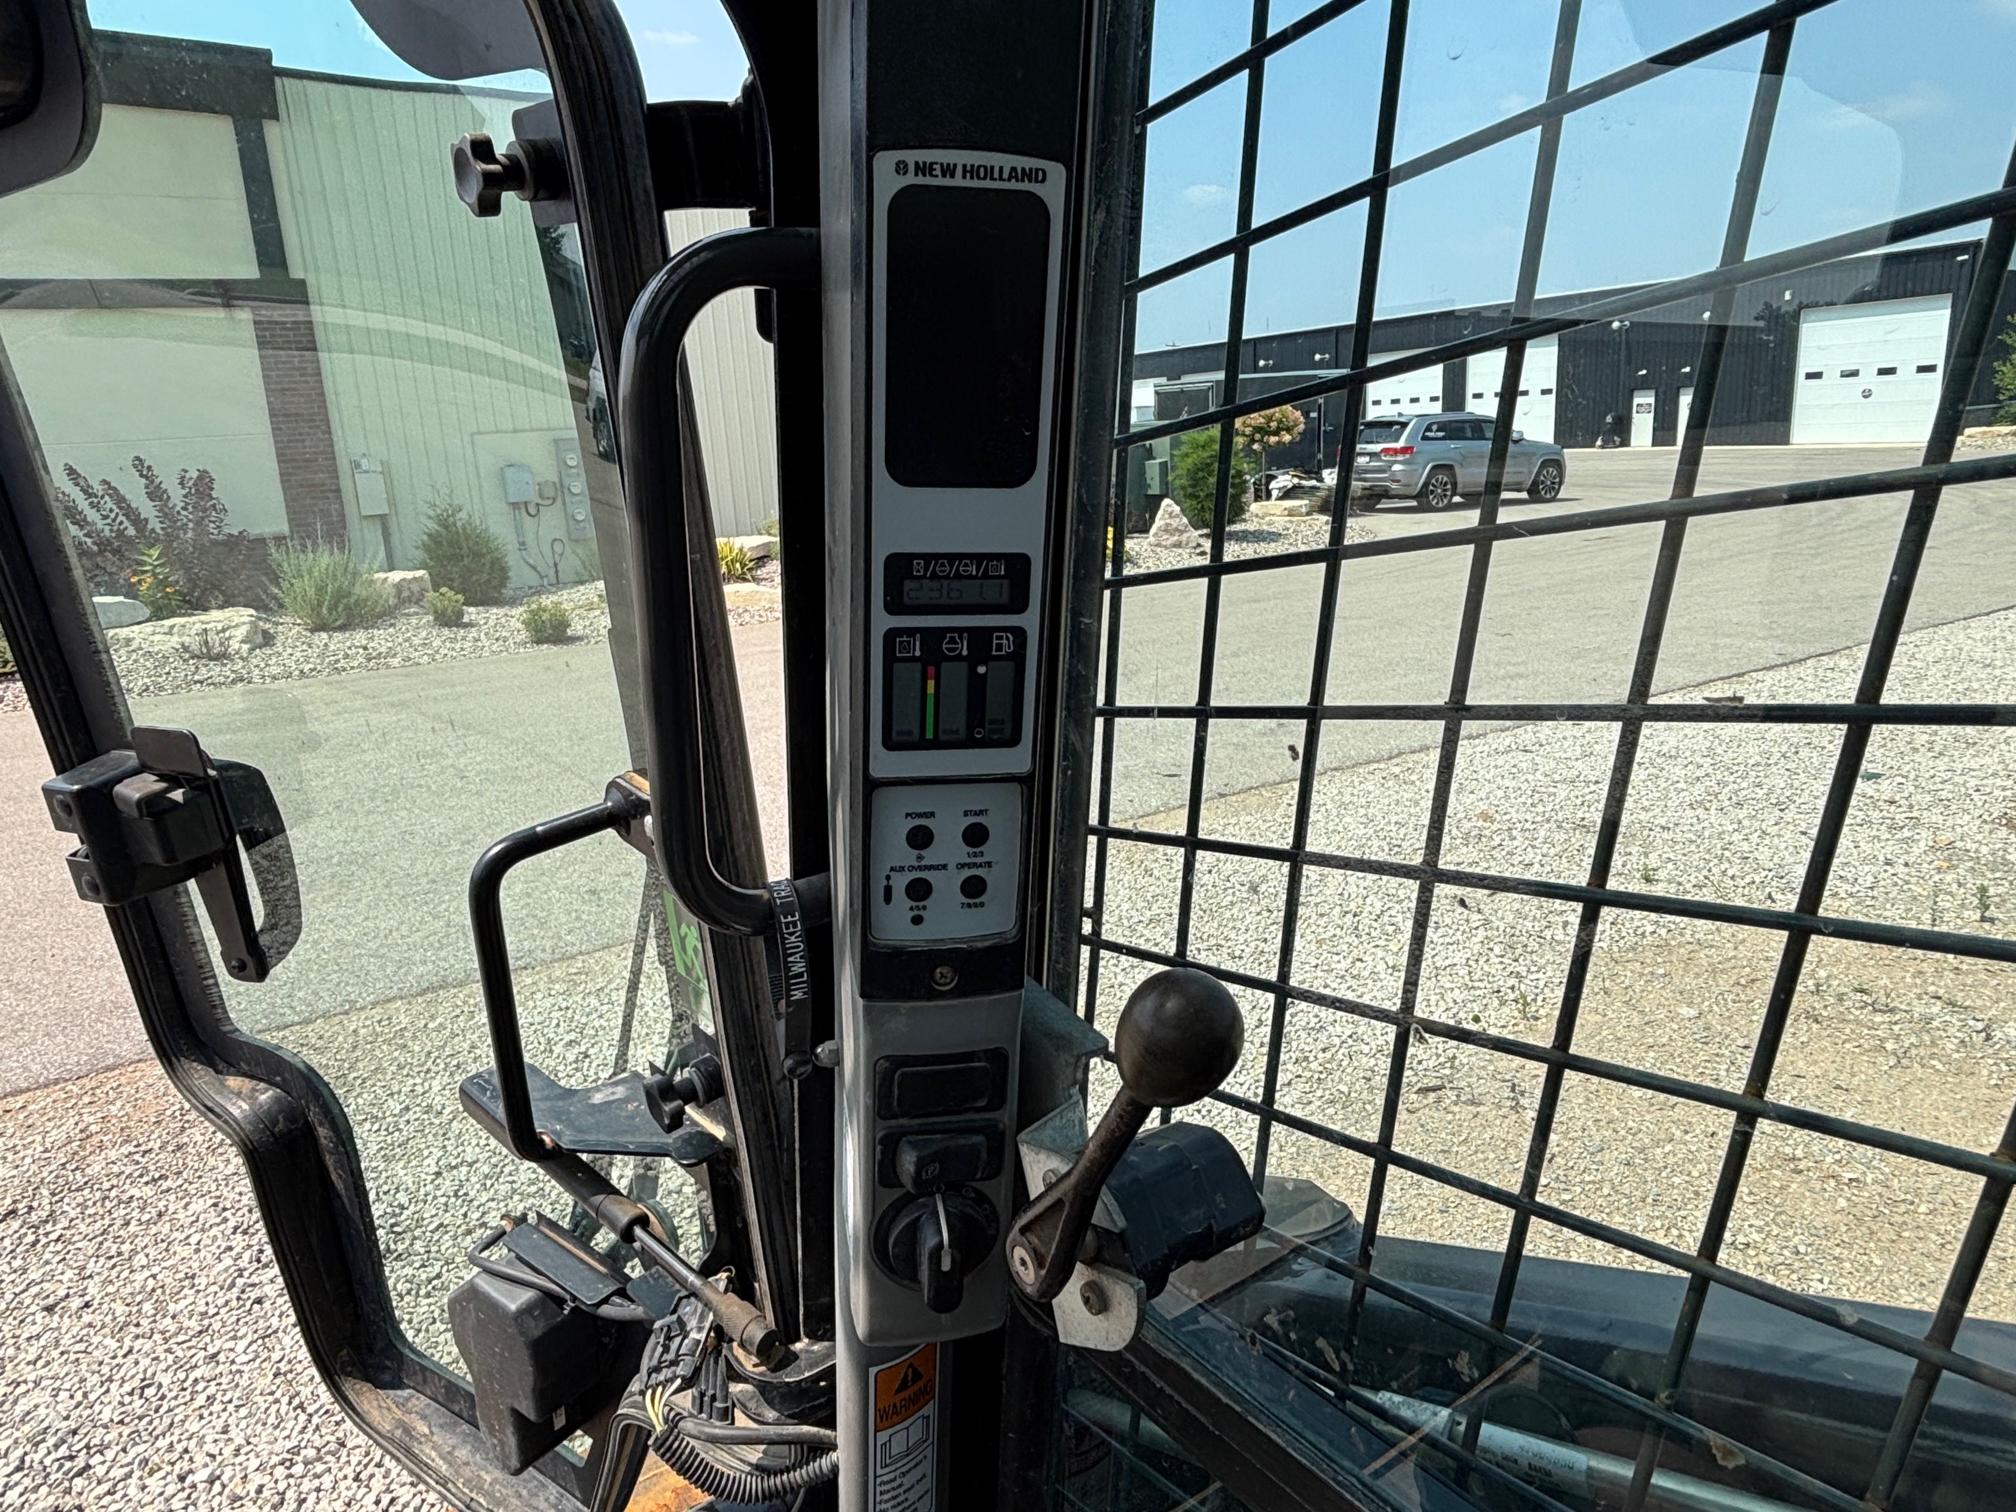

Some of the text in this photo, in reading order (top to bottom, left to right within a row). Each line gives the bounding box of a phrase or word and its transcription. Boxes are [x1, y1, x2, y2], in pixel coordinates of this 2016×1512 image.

[914, 160, 1047, 184] NEW HOLLAND
[905, 811, 936, 820] POWER
[963, 809, 989, 817] START
[889, 863, 949, 873] AUX OVERRIDE
[956, 861, 993, 870] OPERATE
[780, 911, 809, 1001] MILWAUKEE
[878, 1379, 933, 1424] WARNING
